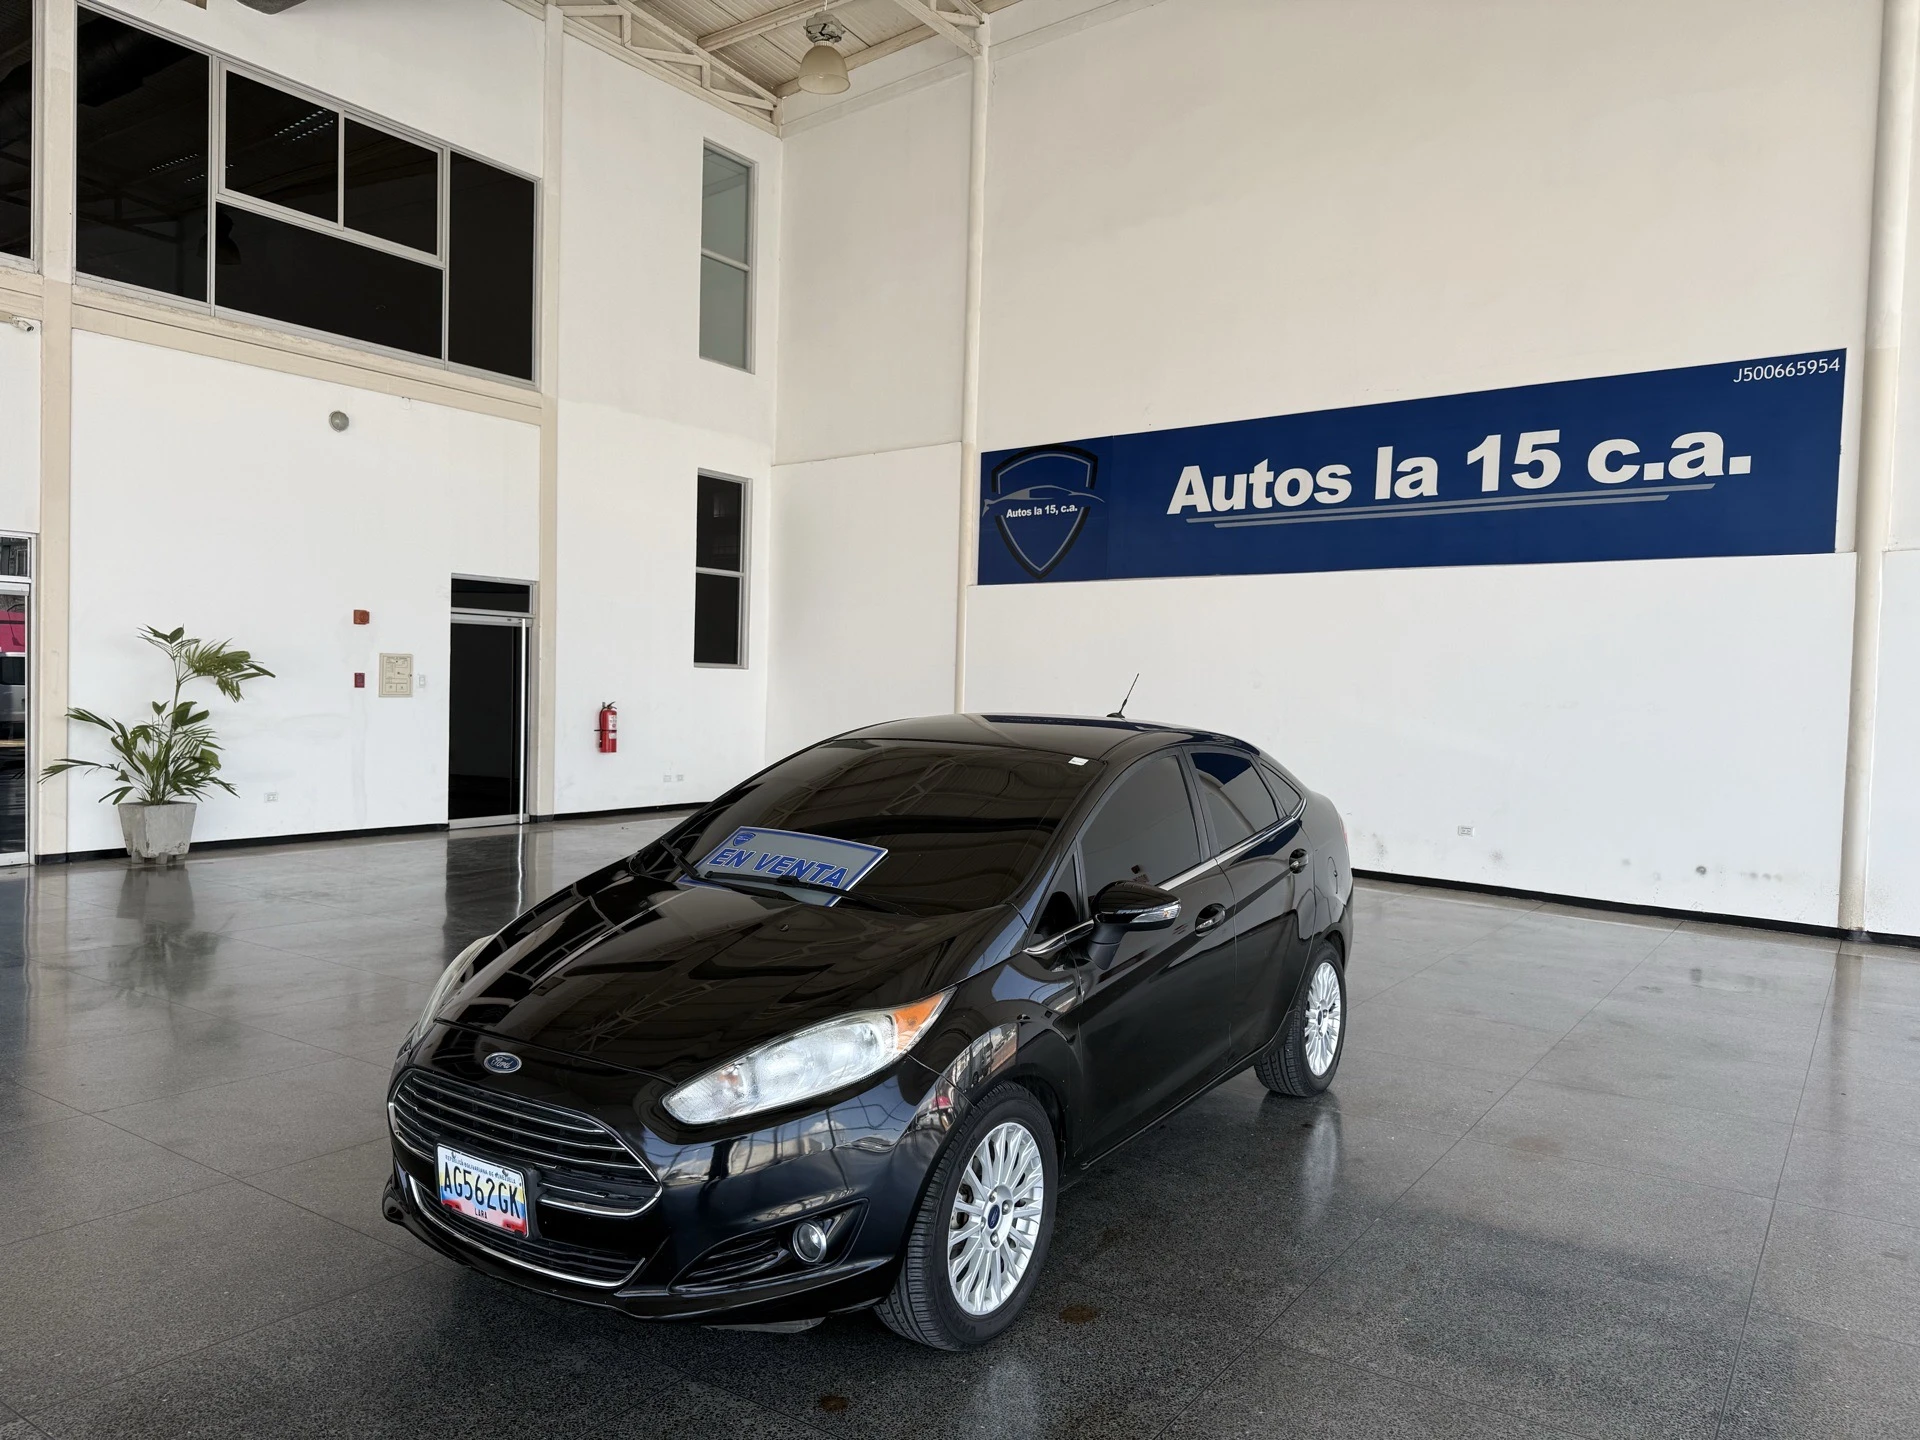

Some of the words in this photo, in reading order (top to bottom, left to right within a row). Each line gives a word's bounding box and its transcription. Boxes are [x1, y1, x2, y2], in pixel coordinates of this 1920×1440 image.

[1733, 357, 1840, 383] J500665954
[1166, 458, 1352, 515] Autos
[1375, 446, 1438, 500] la
[1466, 429, 1561, 492] 15
[1587, 431, 1752, 484] c.a.
[1006, 508, 1032, 518] Autos
[1033, 506, 1043, 516] la
[1044, 504, 1059, 516] 15,
[1060, 504, 1078, 514] c.a.
[708, 848, 755, 868] EN
[753, 853, 848, 887] VENTA
[490, 1055, 514, 1069] Ford
[444, 1162, 520, 1219] AG562GK
[474, 1207, 488, 1220] LARA
